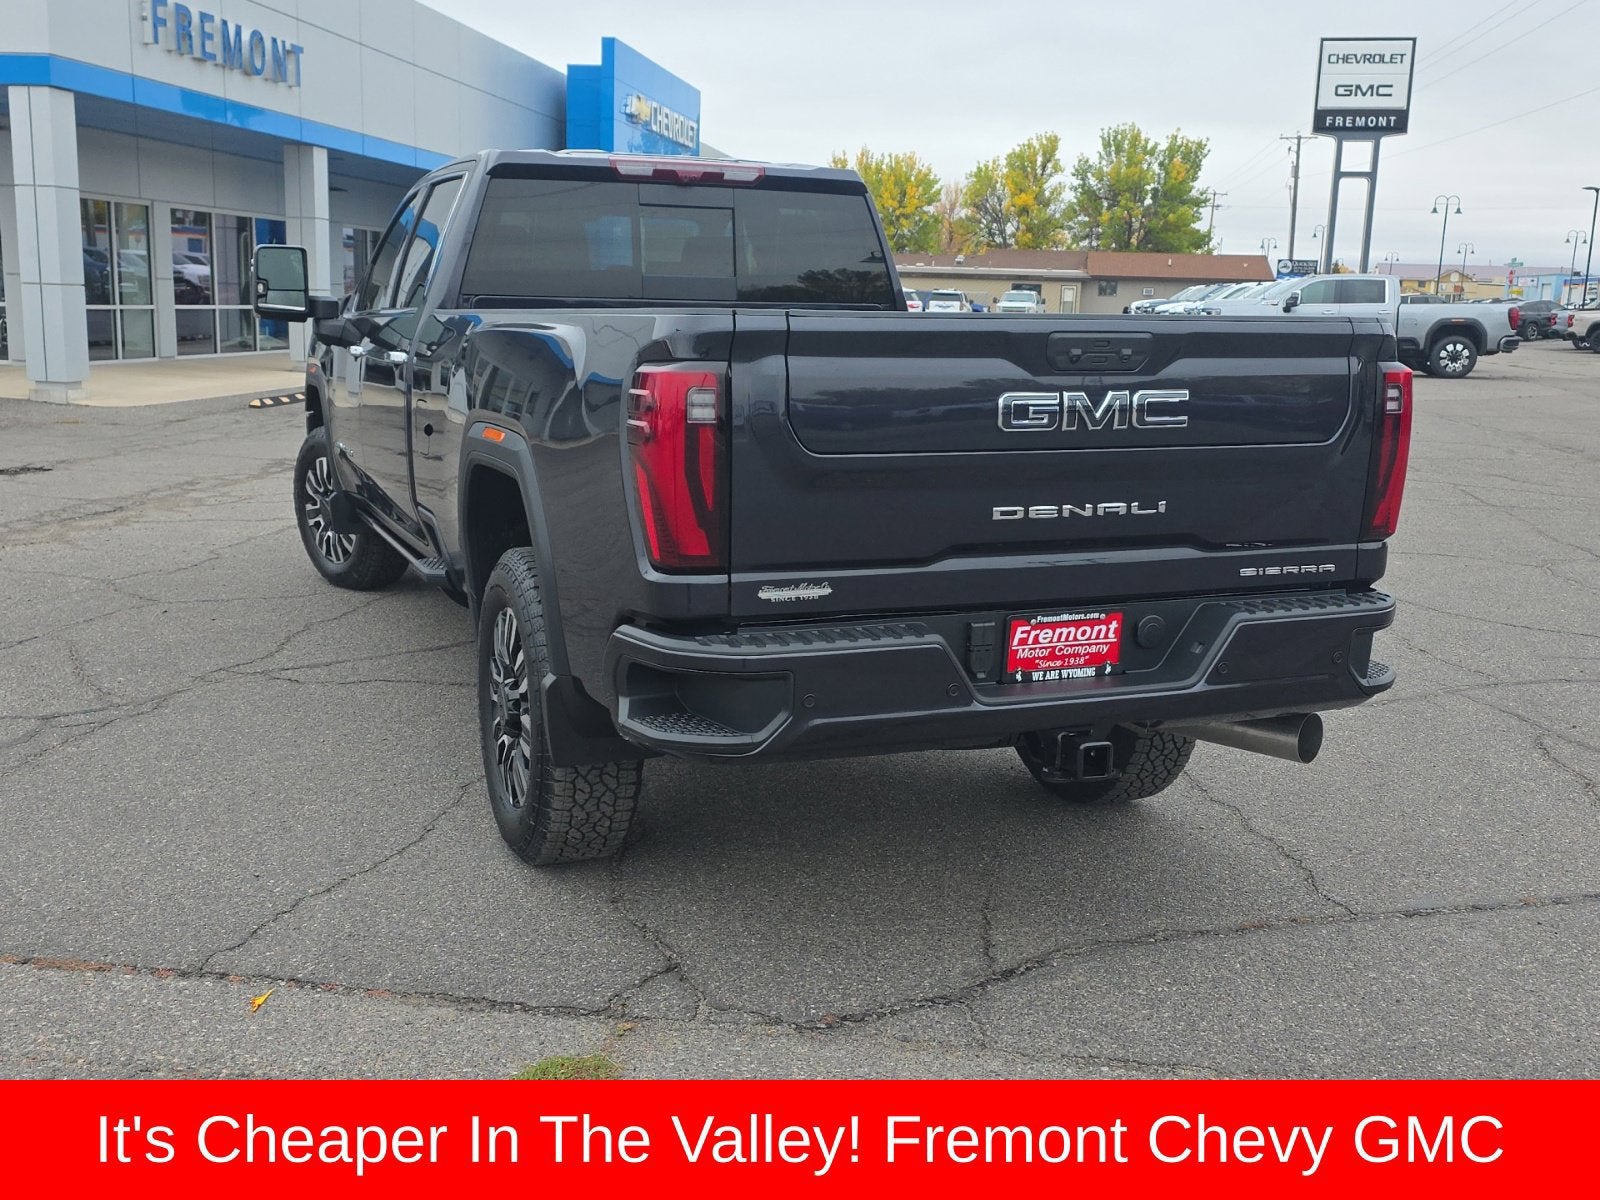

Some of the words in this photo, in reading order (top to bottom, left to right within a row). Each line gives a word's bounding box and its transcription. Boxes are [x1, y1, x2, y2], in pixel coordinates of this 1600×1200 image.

[146, 0, 304, 88] FREMONT
[1327, 53, 1407, 65] CHEVROLET
[1334, 84, 1394, 97] GMC
[651, 101, 698, 149] CHEVROLET
[1326, 116, 1397, 128] FREMONT
[997, 389, 1190, 432] GMC
[992, 501, 1167, 521] DENALI
[1239, 564, 1337, 578] SIERRA
[1036, 612, 1100, 623] FremontMotors.com
[1012, 620, 1119, 647] Fremont
[1016, 648, 1052, 659] Motor
[1055, 644, 1110, 656] Company
[1032, 671, 1044, 681] WE
[1045, 669, 1060, 680] ARE
[1061, 667, 1096, 679] WYOMING
